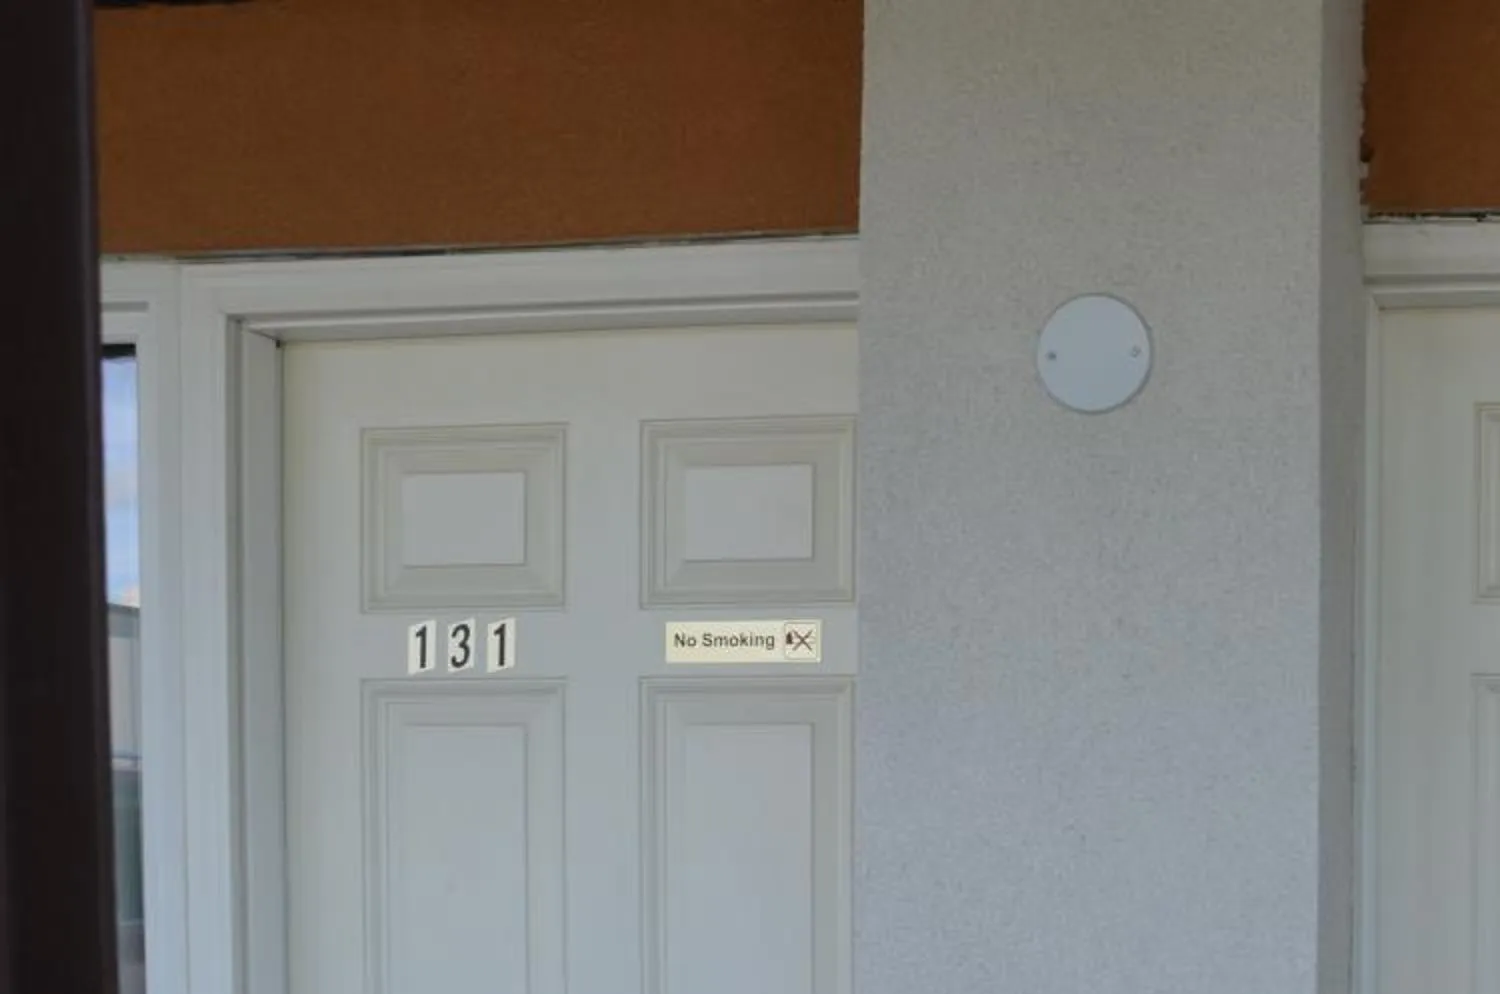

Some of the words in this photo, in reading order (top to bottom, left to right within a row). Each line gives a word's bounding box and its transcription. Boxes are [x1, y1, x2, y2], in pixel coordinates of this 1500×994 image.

[414, 621, 507, 669] 131
[673, 632, 697, 648] No
[702, 631, 776, 651] Smoking
